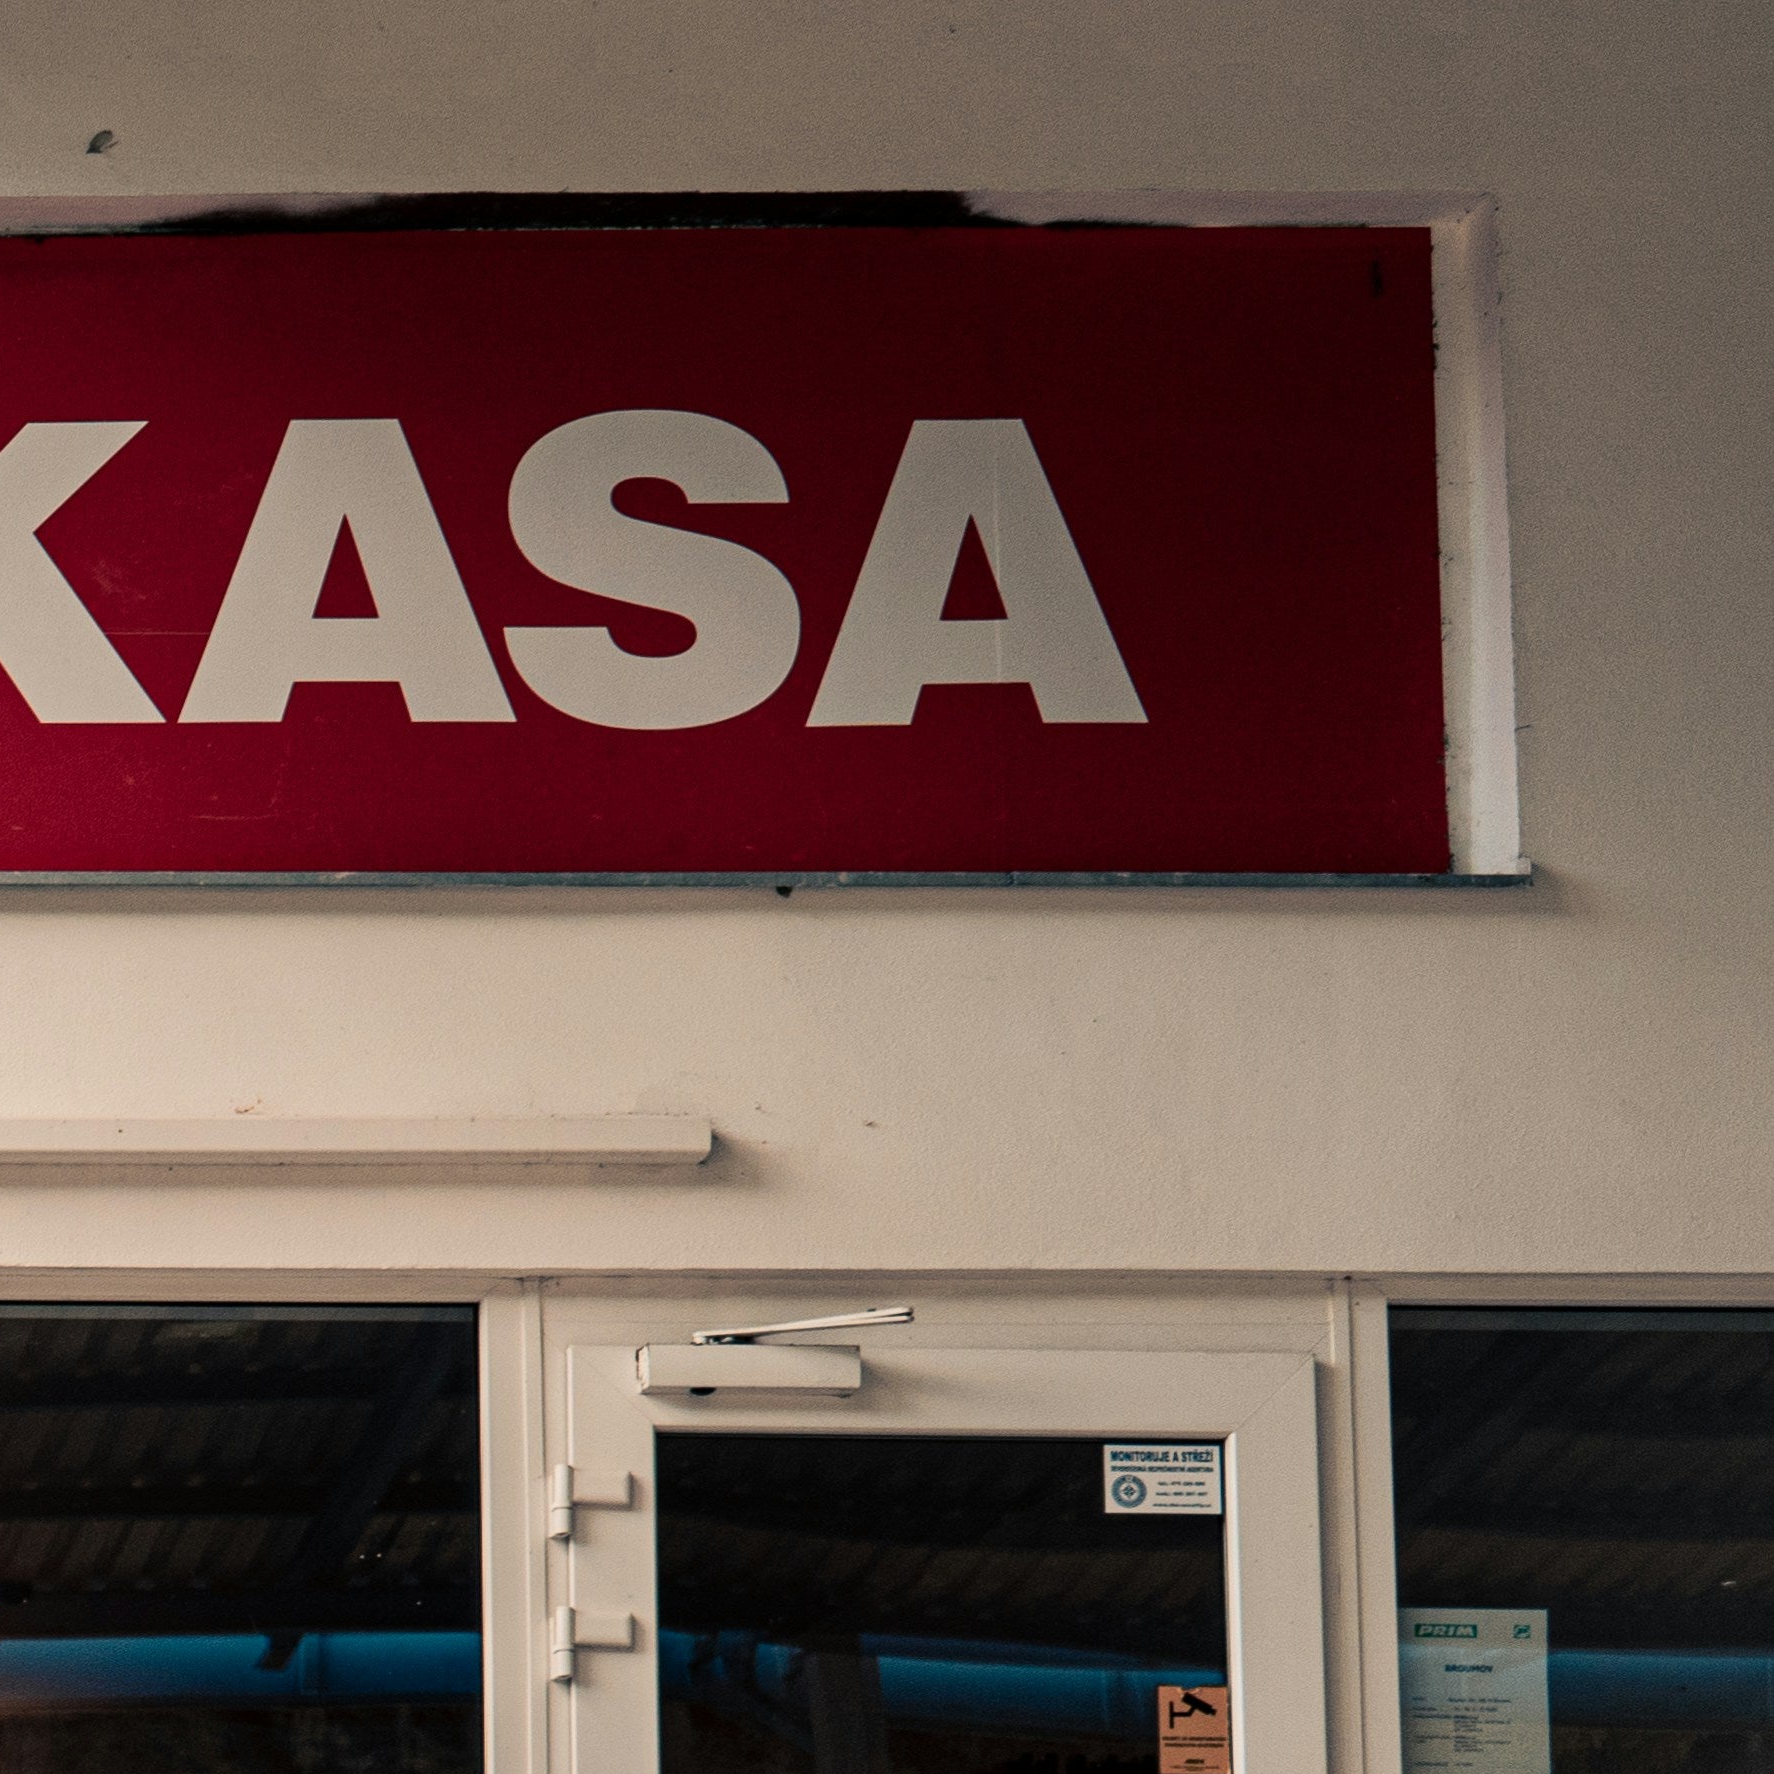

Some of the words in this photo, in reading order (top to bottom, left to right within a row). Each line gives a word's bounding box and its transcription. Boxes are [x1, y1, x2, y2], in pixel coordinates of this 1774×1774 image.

[1110, 1450, 1169, 1462] MONITORUJE
[1172, 1451, 1179, 1462] A
[1181, 1449, 1213, 1462] STŘEŽÍ
[1419, 1625, 1474, 1636] PRIM
